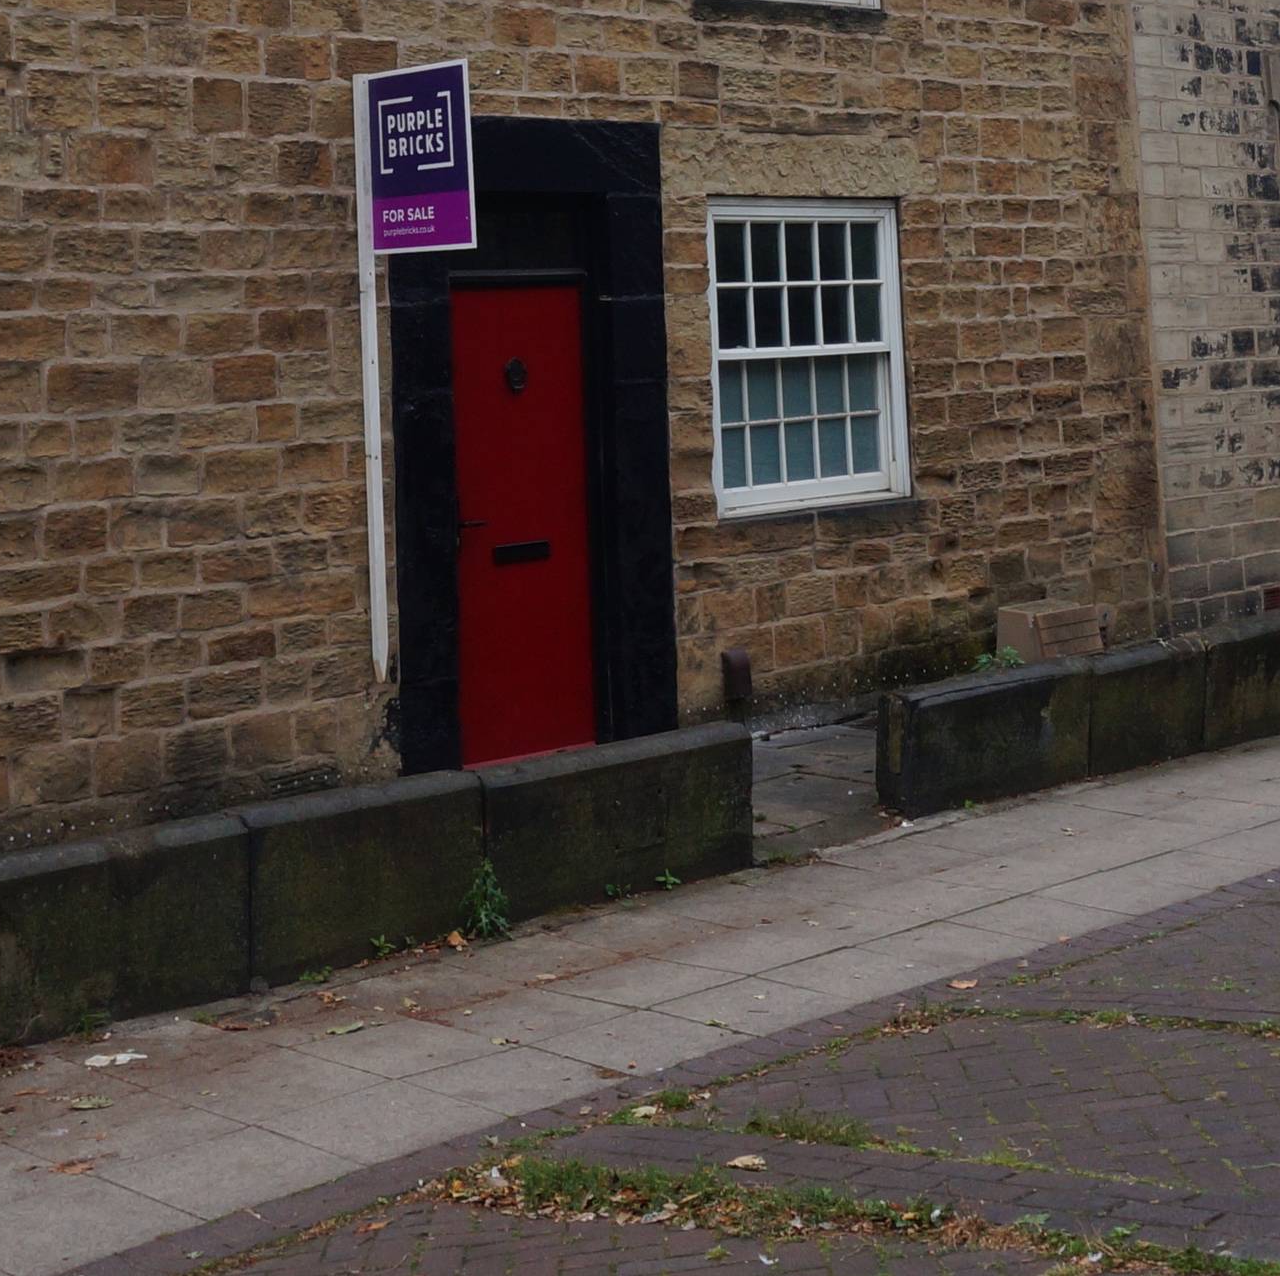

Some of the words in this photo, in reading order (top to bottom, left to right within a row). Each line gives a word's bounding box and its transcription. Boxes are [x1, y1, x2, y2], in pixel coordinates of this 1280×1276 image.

[387, 108, 443, 134] PURPLE
[388, 132, 445, 158] BRICKS
[383, 209, 405, 223] FOR
[407, 206, 435, 221] SALE
[383, 225, 435, 238] purplebricks.co.uk
